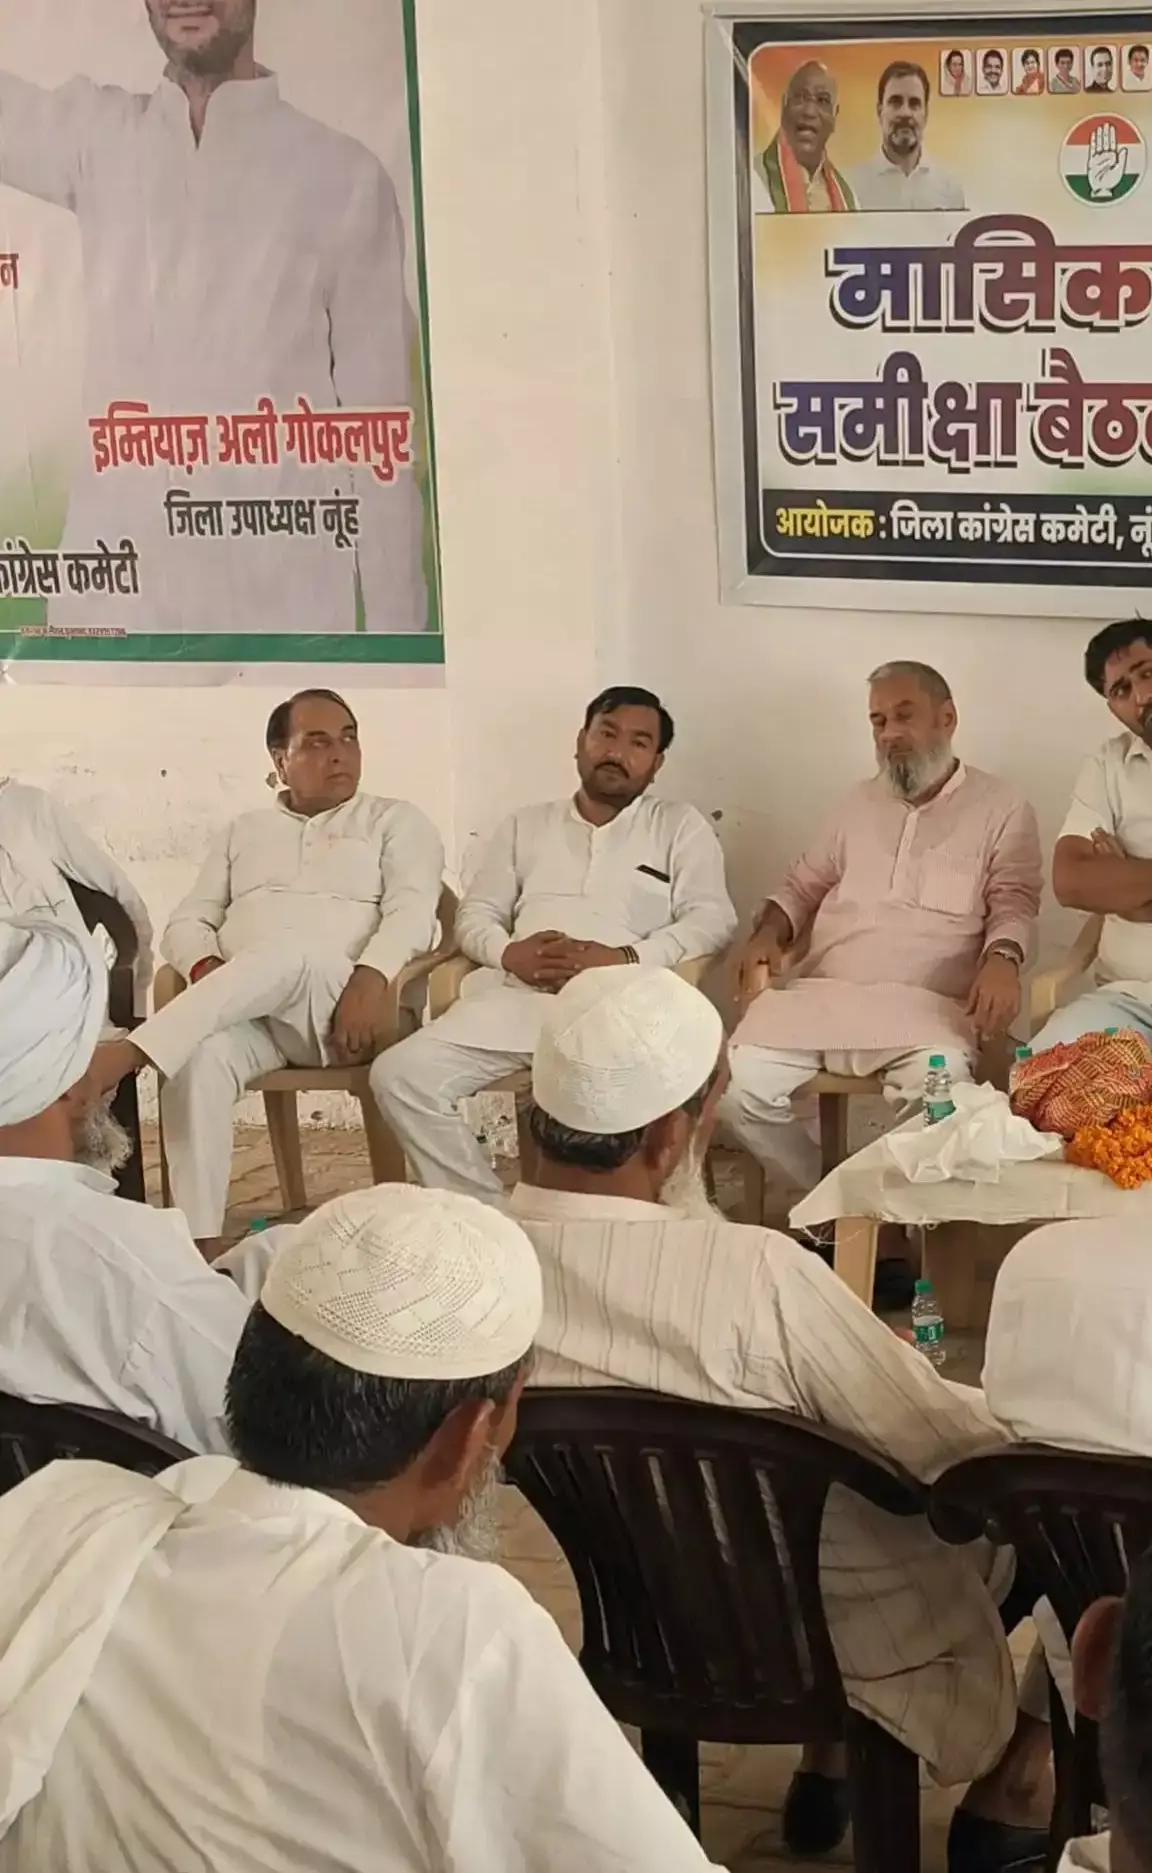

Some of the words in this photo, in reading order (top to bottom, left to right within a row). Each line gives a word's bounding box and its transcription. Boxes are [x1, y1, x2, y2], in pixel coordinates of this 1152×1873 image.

[89, 402, 208, 474] इम्तियाज़
[217, 398, 278, 465] अली
[282, 397, 410, 481] गोकलपुर
[773, 351, 1023, 474] समीक्षा
[164, 491, 224, 536] जिला
[227, 499, 316, 536] उपाध्यक्ष
[320, 490, 359, 548] नूंह
[889, 500, 953, 541] जिला
[957, 502, 1035, 543] कांग्रेस
[1040, 504, 1124, 551] कमेटी,
[62, 539, 139, 594] कमेटी
